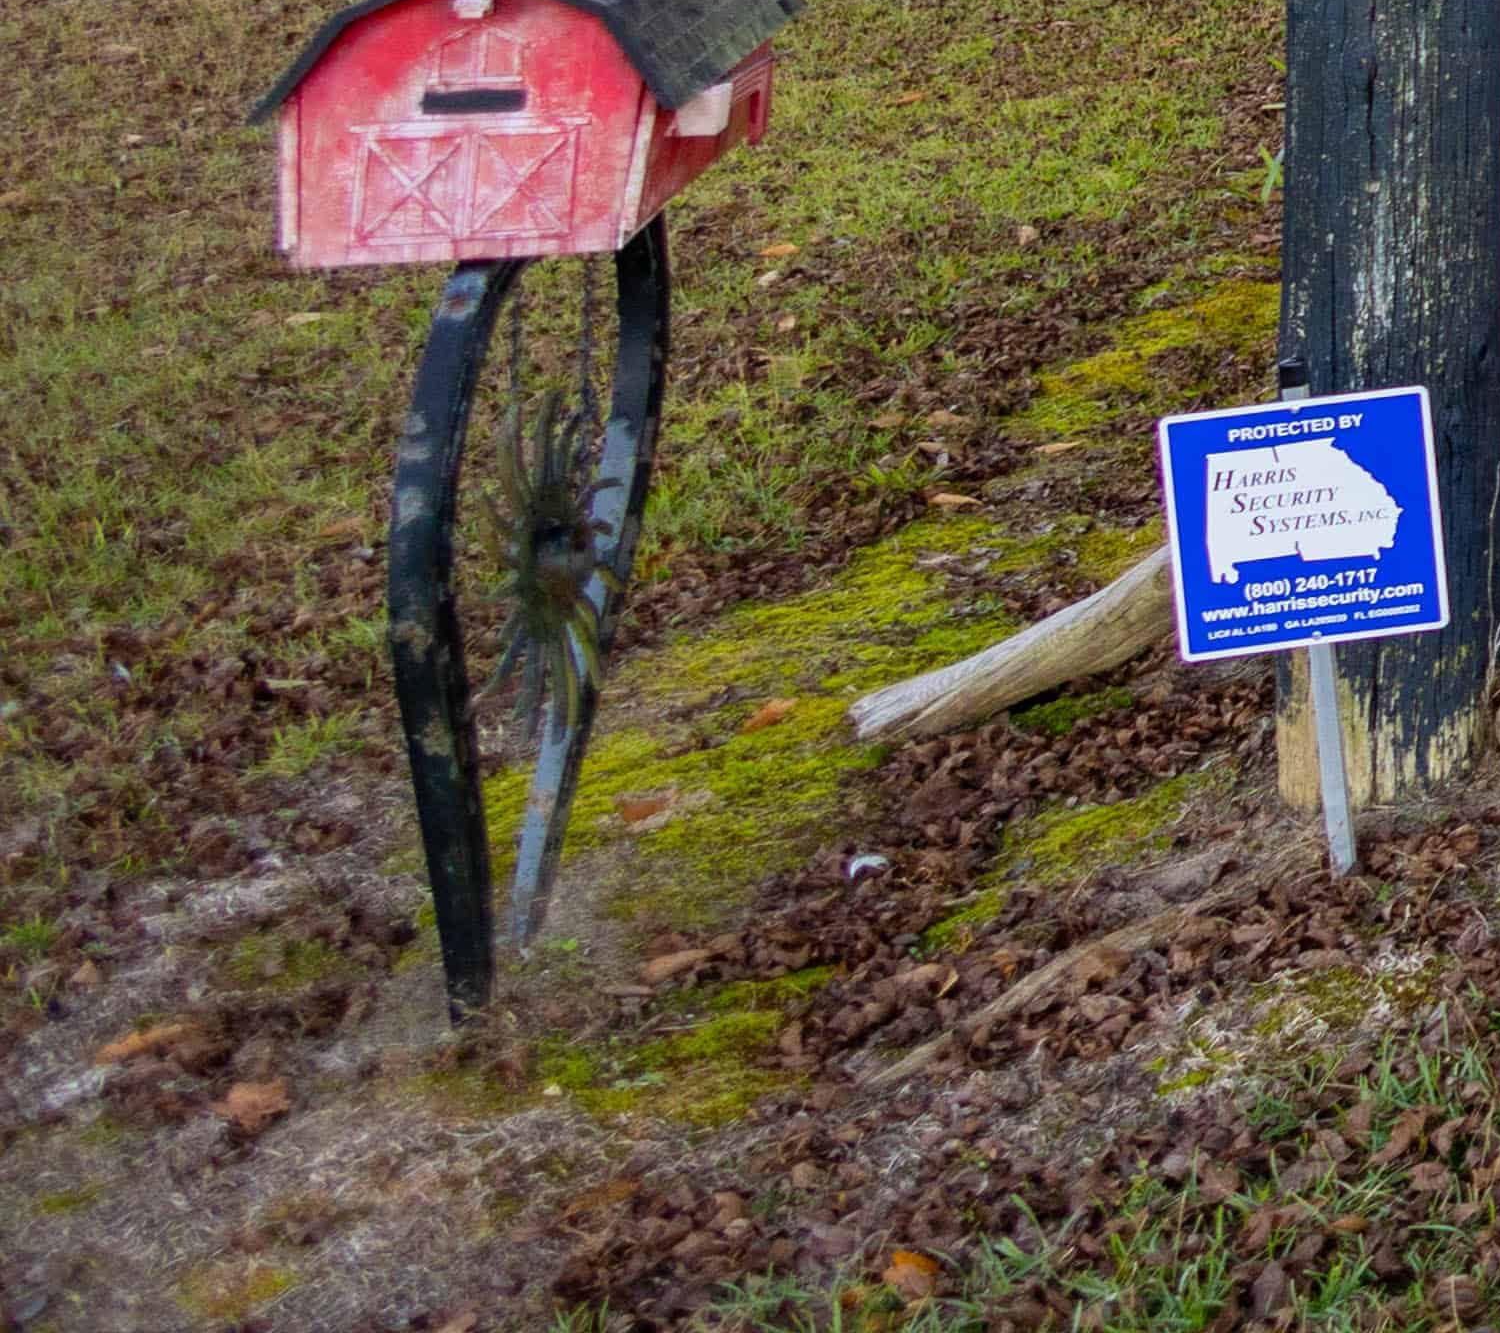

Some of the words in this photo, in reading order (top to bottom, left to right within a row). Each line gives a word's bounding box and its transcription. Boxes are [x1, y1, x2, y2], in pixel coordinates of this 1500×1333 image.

[1228, 417, 1335, 442] PROTECTED
[1338, 413, 1363, 429] BY
[1213, 467, 1297, 491] HARRIS
[1231, 486, 1338, 514] SECURITY
[1250, 509, 1352, 536] SYSTEMS,
[1244, 579, 1291, 601] (800)
[1295, 568, 1377, 592] 240-1717
[1202, 582, 1424, 622] www.harrissecurity.com
